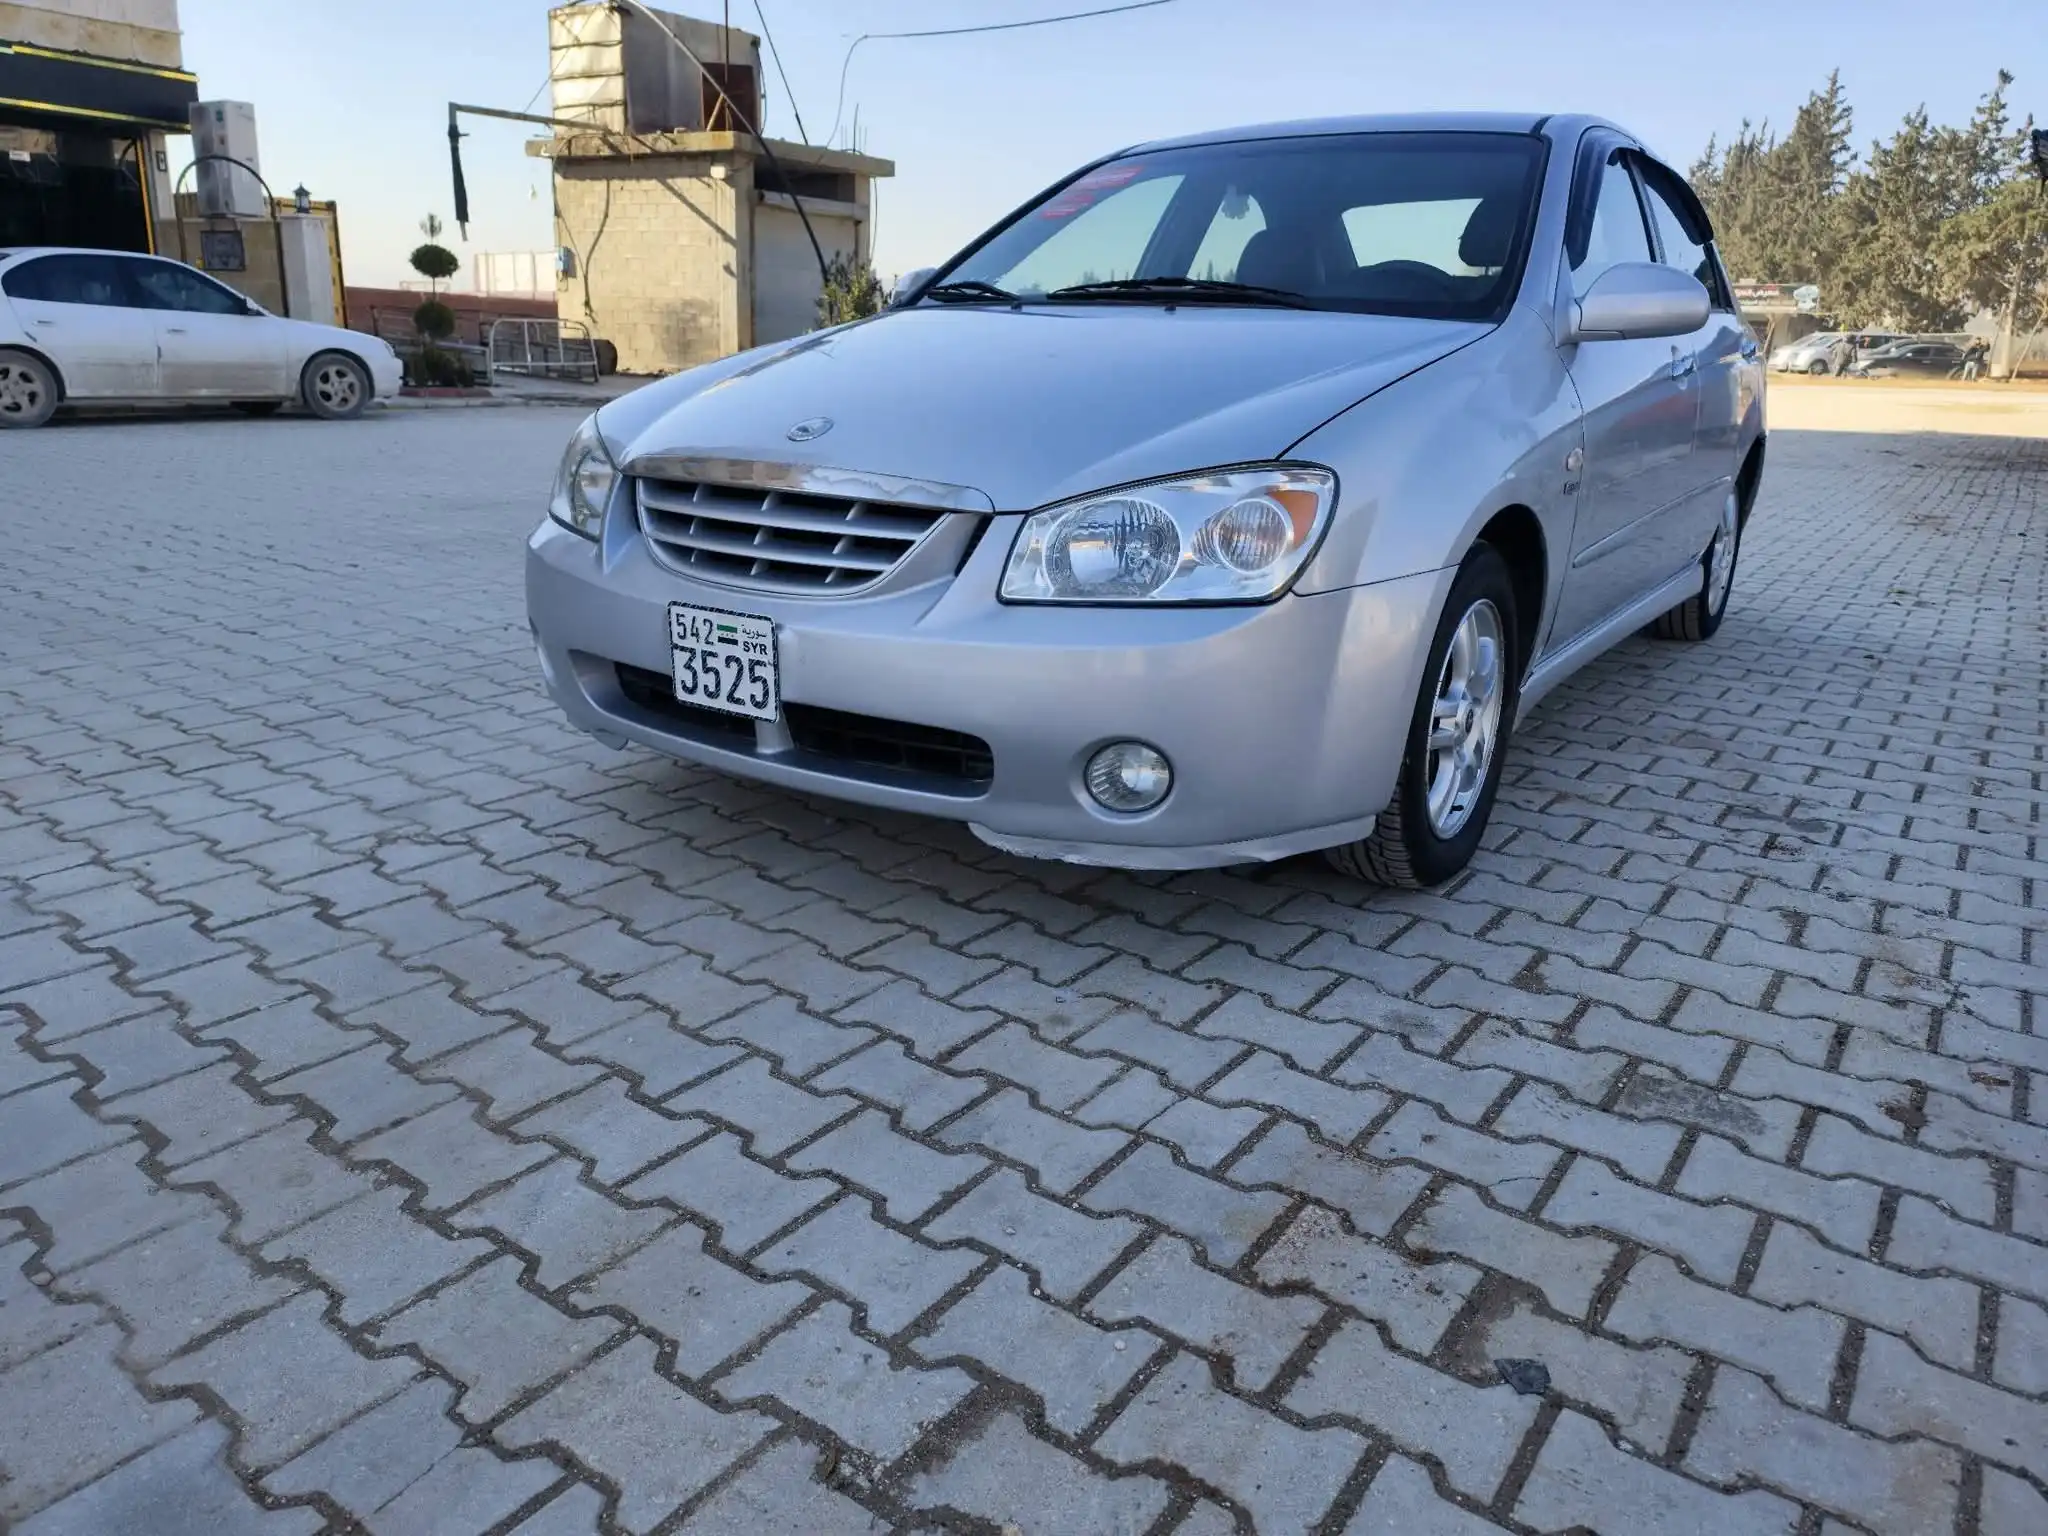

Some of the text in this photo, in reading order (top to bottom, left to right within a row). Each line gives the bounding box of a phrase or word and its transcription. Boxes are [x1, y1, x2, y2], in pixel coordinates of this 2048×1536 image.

[675, 613, 714, 645] 542
[742, 641, 768, 655] SYR
[672, 643, 770, 710] 3525
